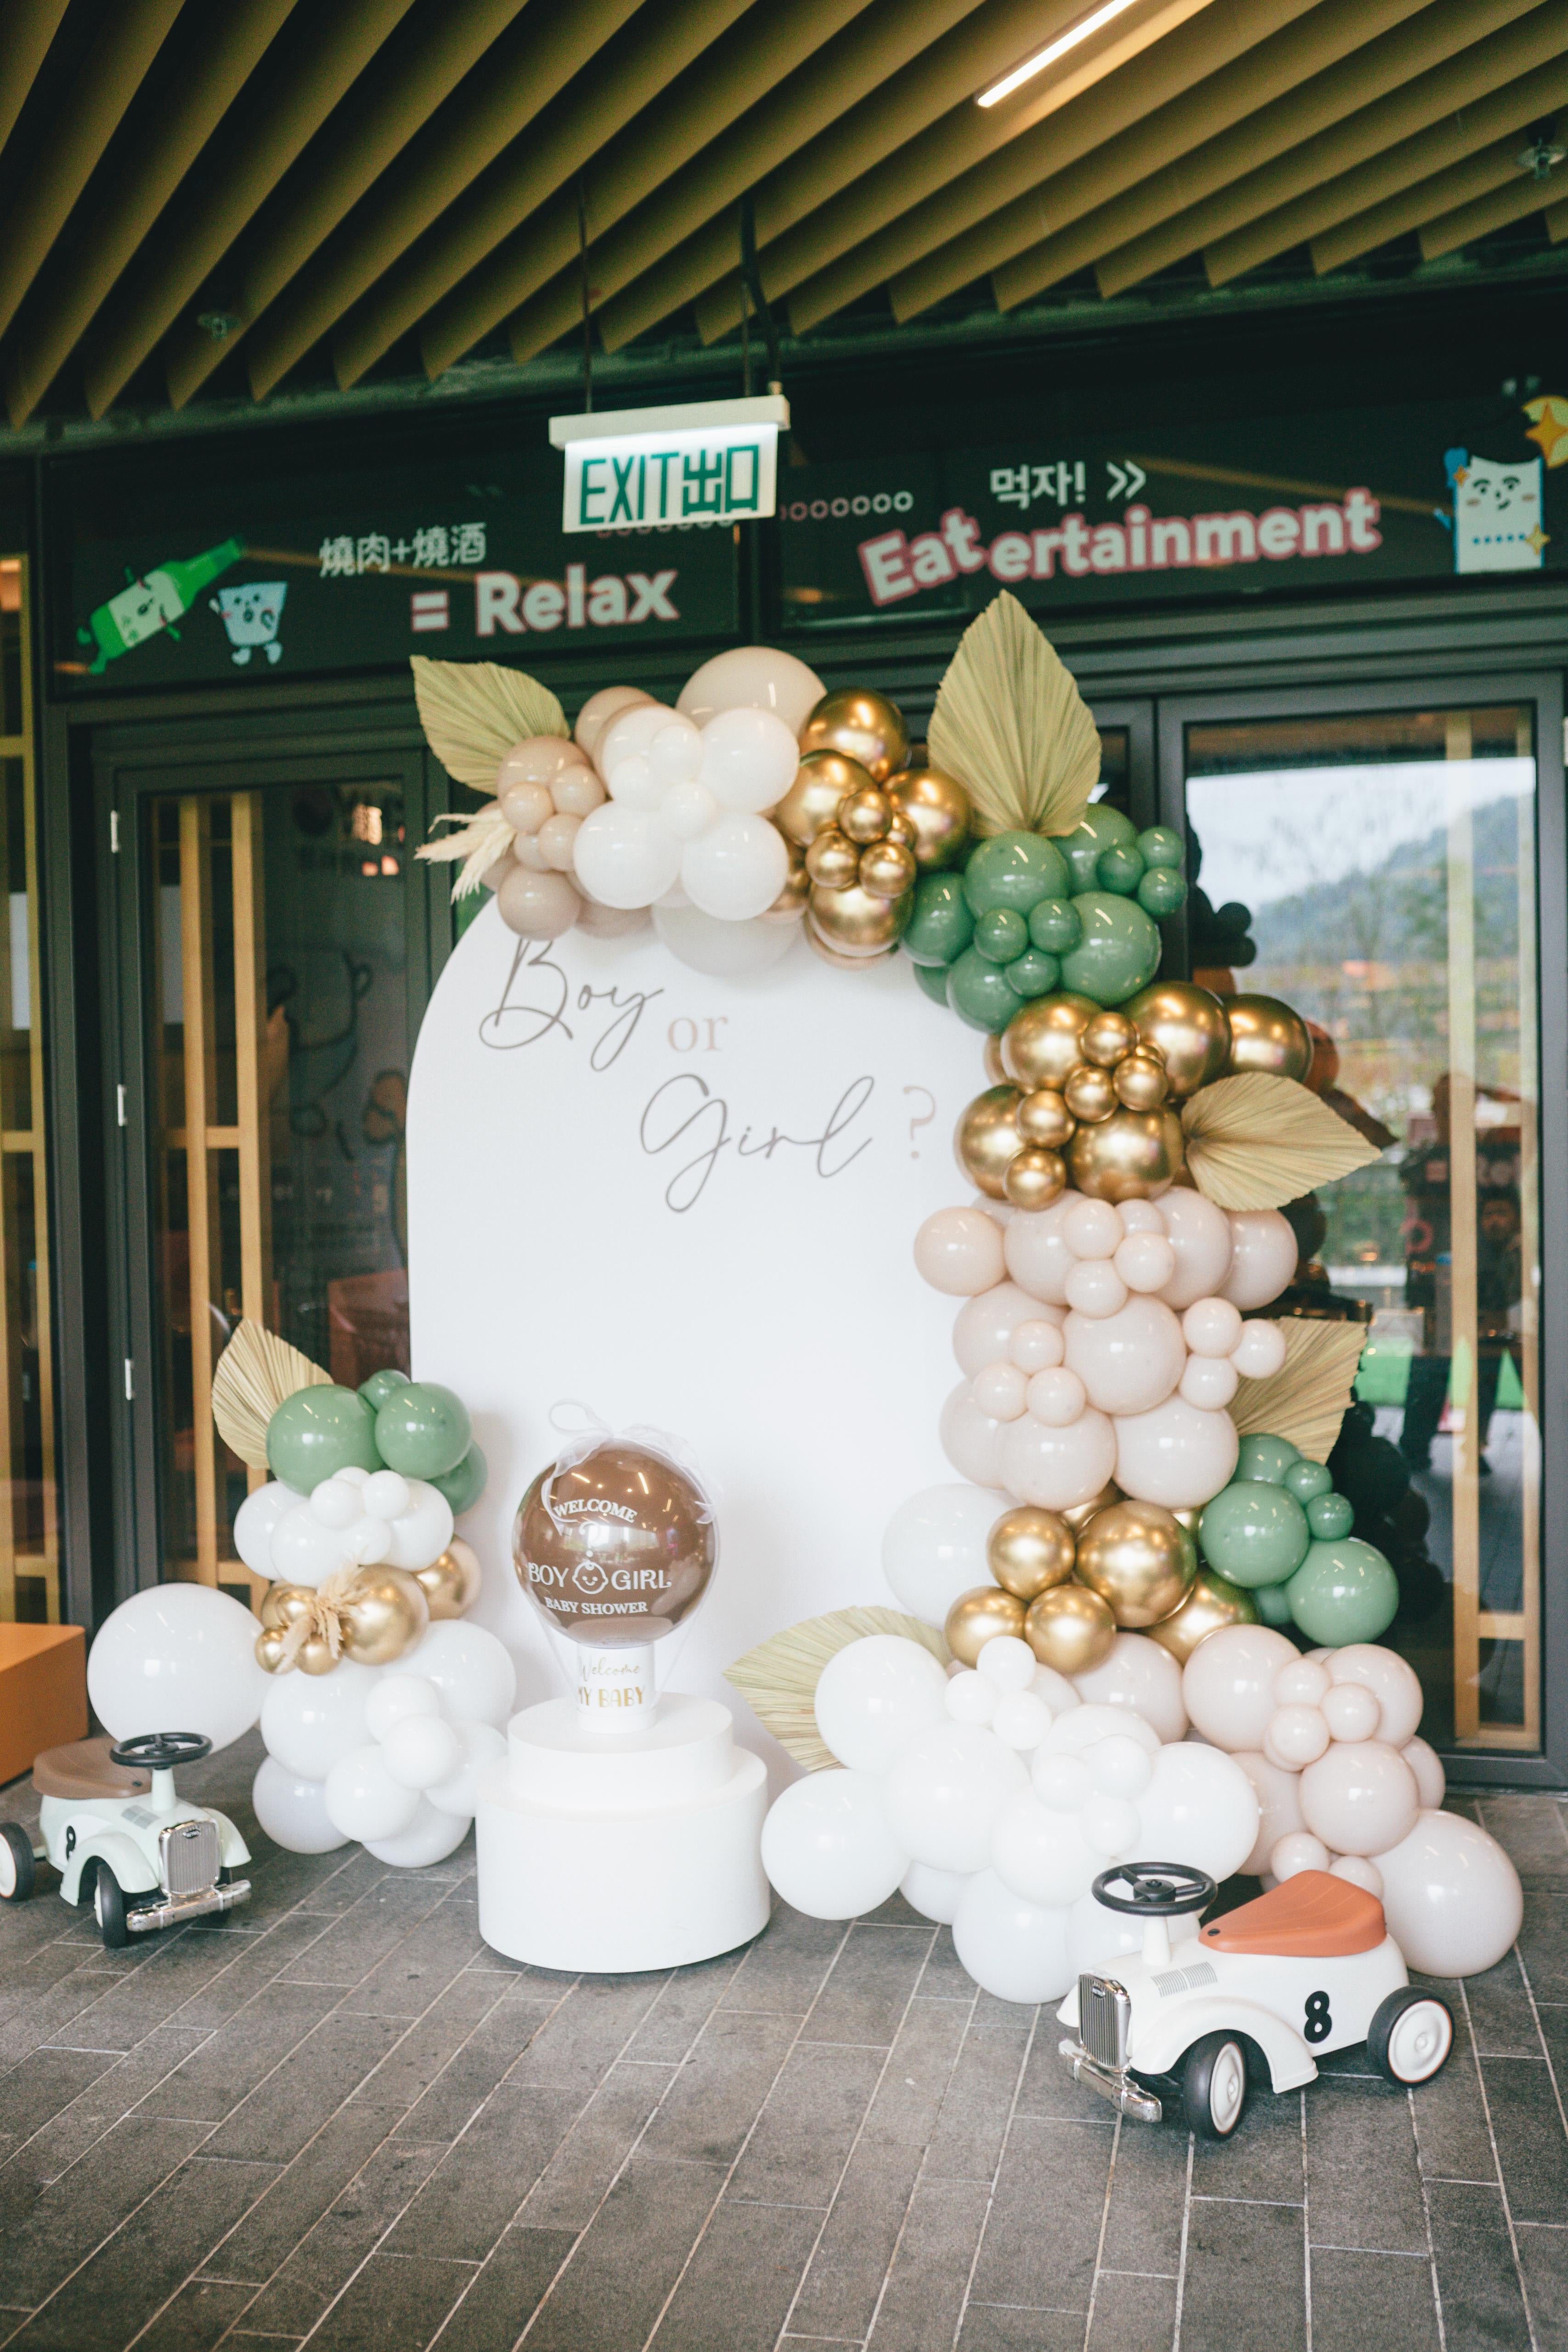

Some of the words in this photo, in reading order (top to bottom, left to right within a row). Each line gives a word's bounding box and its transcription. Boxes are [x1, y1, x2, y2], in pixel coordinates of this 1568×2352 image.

[989, 460, 1086, 509] 먹자!
[474, 562, 680, 638] Relax
[479, 937, 664, 1072] Boy
[667, 1014, 728, 1052] or
[640, 1074, 874, 1214] Girl
[553, 1498, 638, 1524] WELCOME
[527, 1562, 569, 1588] BOY
[611, 1569, 672, 1591] GIRL
[543, 1596, 579, 1615] BABY
[581, 1600, 649, 1615] SHOWER
[577, 1655, 640, 1682] Welcome
[598, 1686, 646, 1707] BABY
[1303, 1990, 1332, 2044] 8
